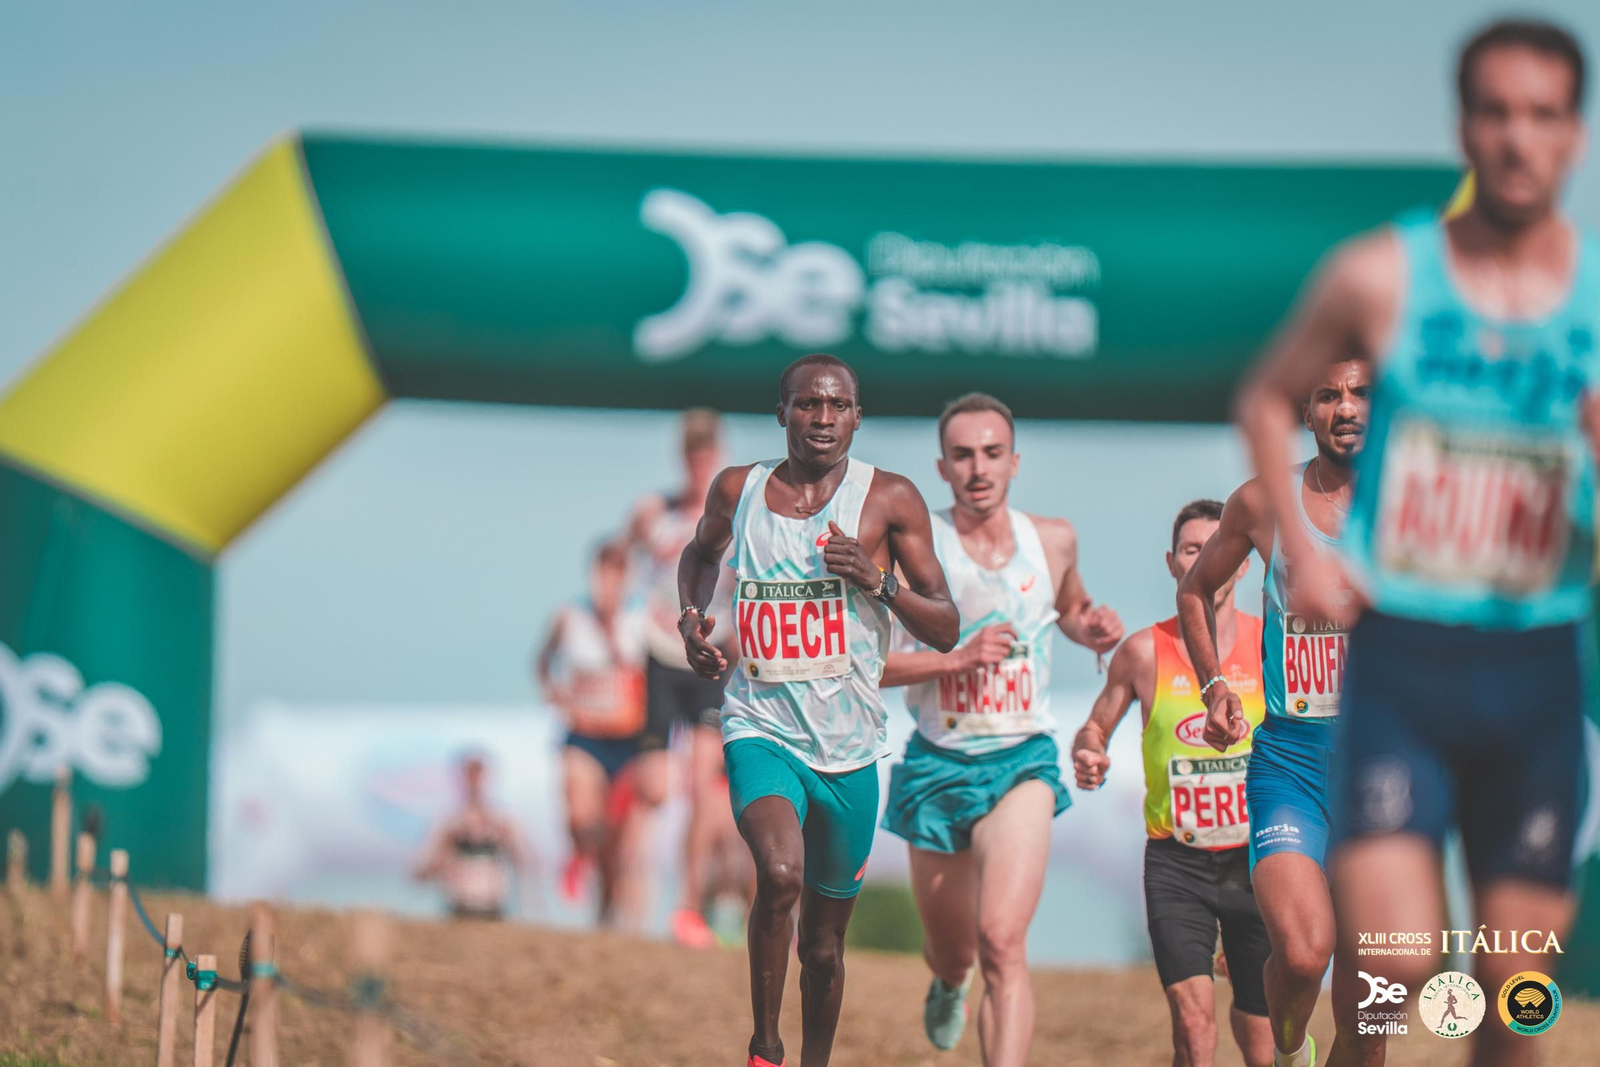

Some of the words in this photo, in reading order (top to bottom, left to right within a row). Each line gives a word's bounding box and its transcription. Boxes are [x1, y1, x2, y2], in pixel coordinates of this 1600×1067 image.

[865, 276, 1097, 358] Sevilla
[763, 584, 815, 597] ITÁLICA
[738, 599, 846, 660] KOECH
[939, 662, 1032, 713] MENACHO
